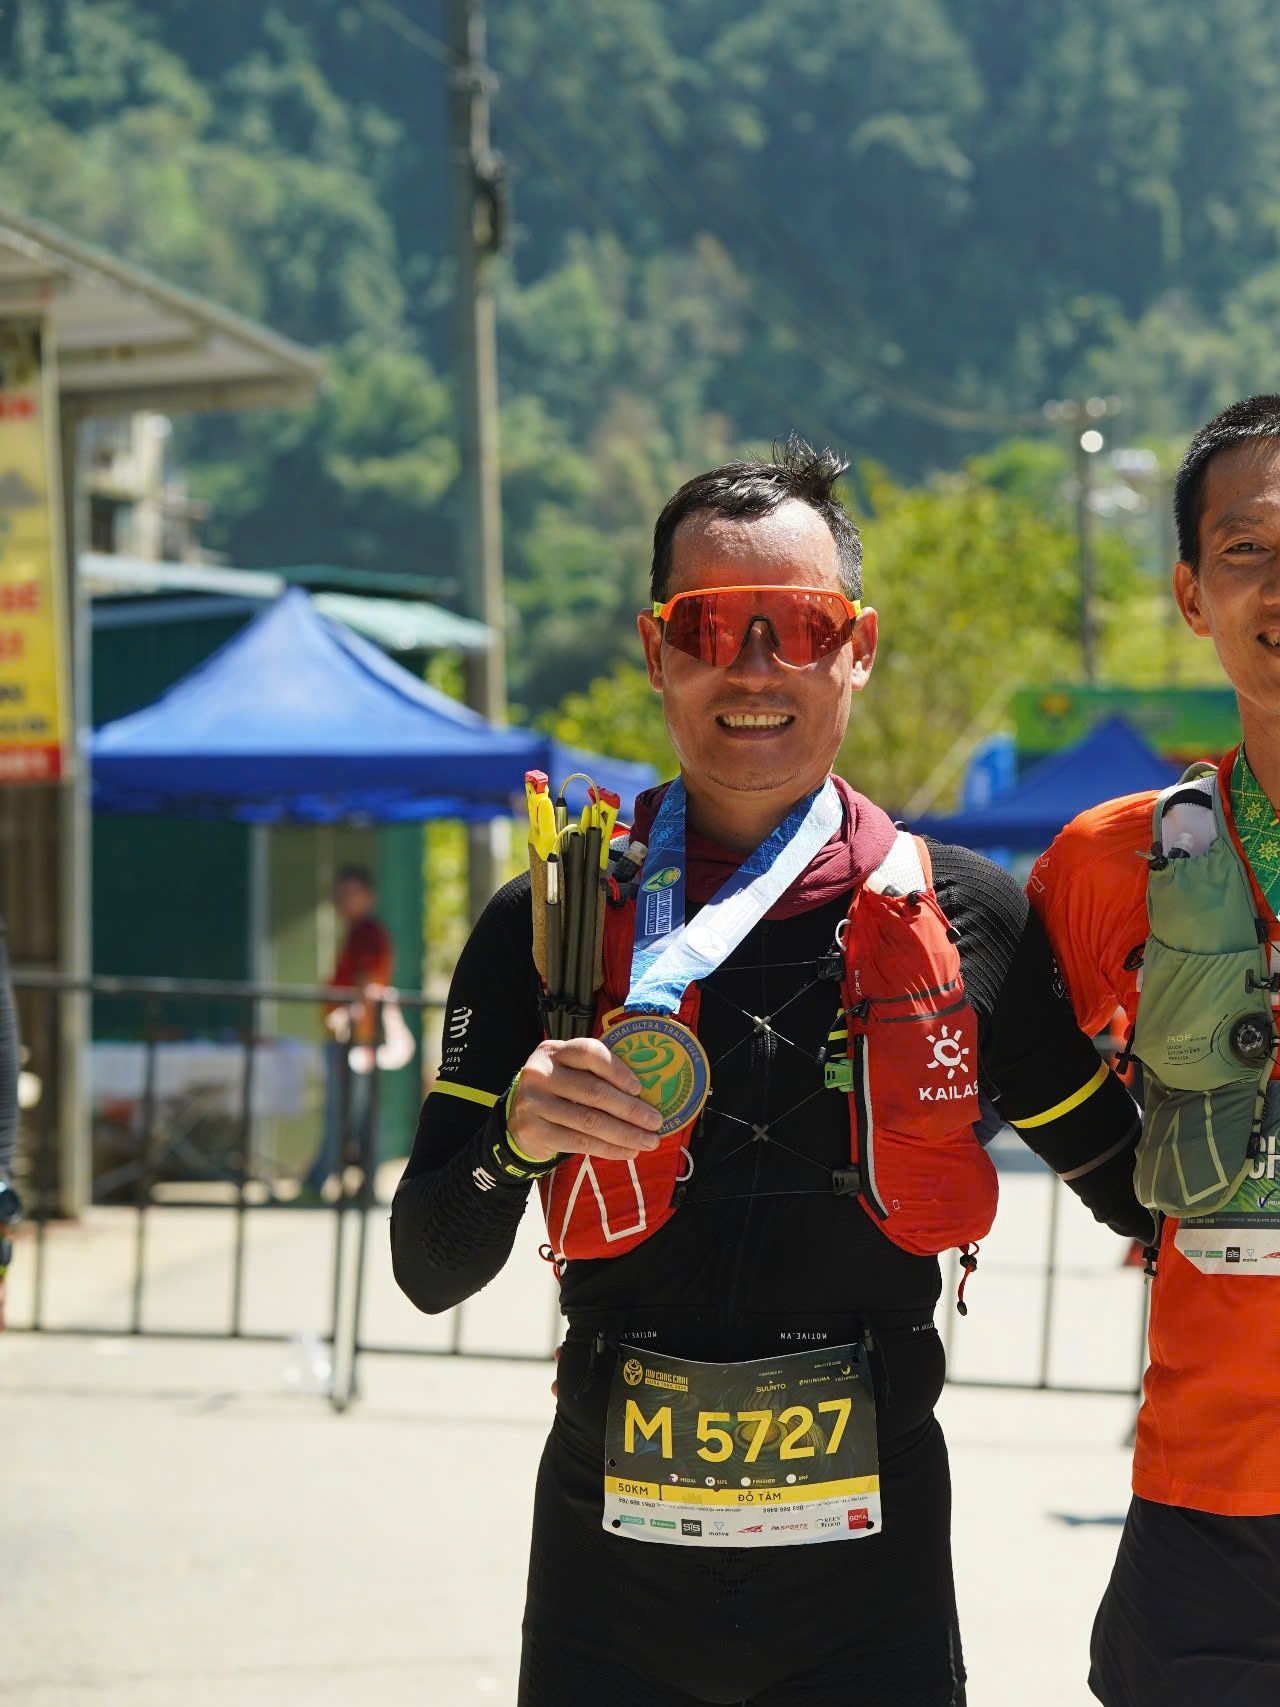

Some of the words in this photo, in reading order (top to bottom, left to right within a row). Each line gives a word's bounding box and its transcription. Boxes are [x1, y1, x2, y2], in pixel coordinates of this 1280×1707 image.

[609, 1025, 629, 1042] CHAI
[632, 1022, 660, 1030] ULTRA
[663, 1025, 686, 1042] TRAIL
[685, 1041, 701, 1062] 2024
[780, 1332, 827, 1340] MOTIVE.VN
[756, 1383, 787, 1393] SUUNTO
[623, 1399, 674, 1459] M
[696, 1397, 852, 1463] 5727
[618, 1482, 649, 1495] 50KM
